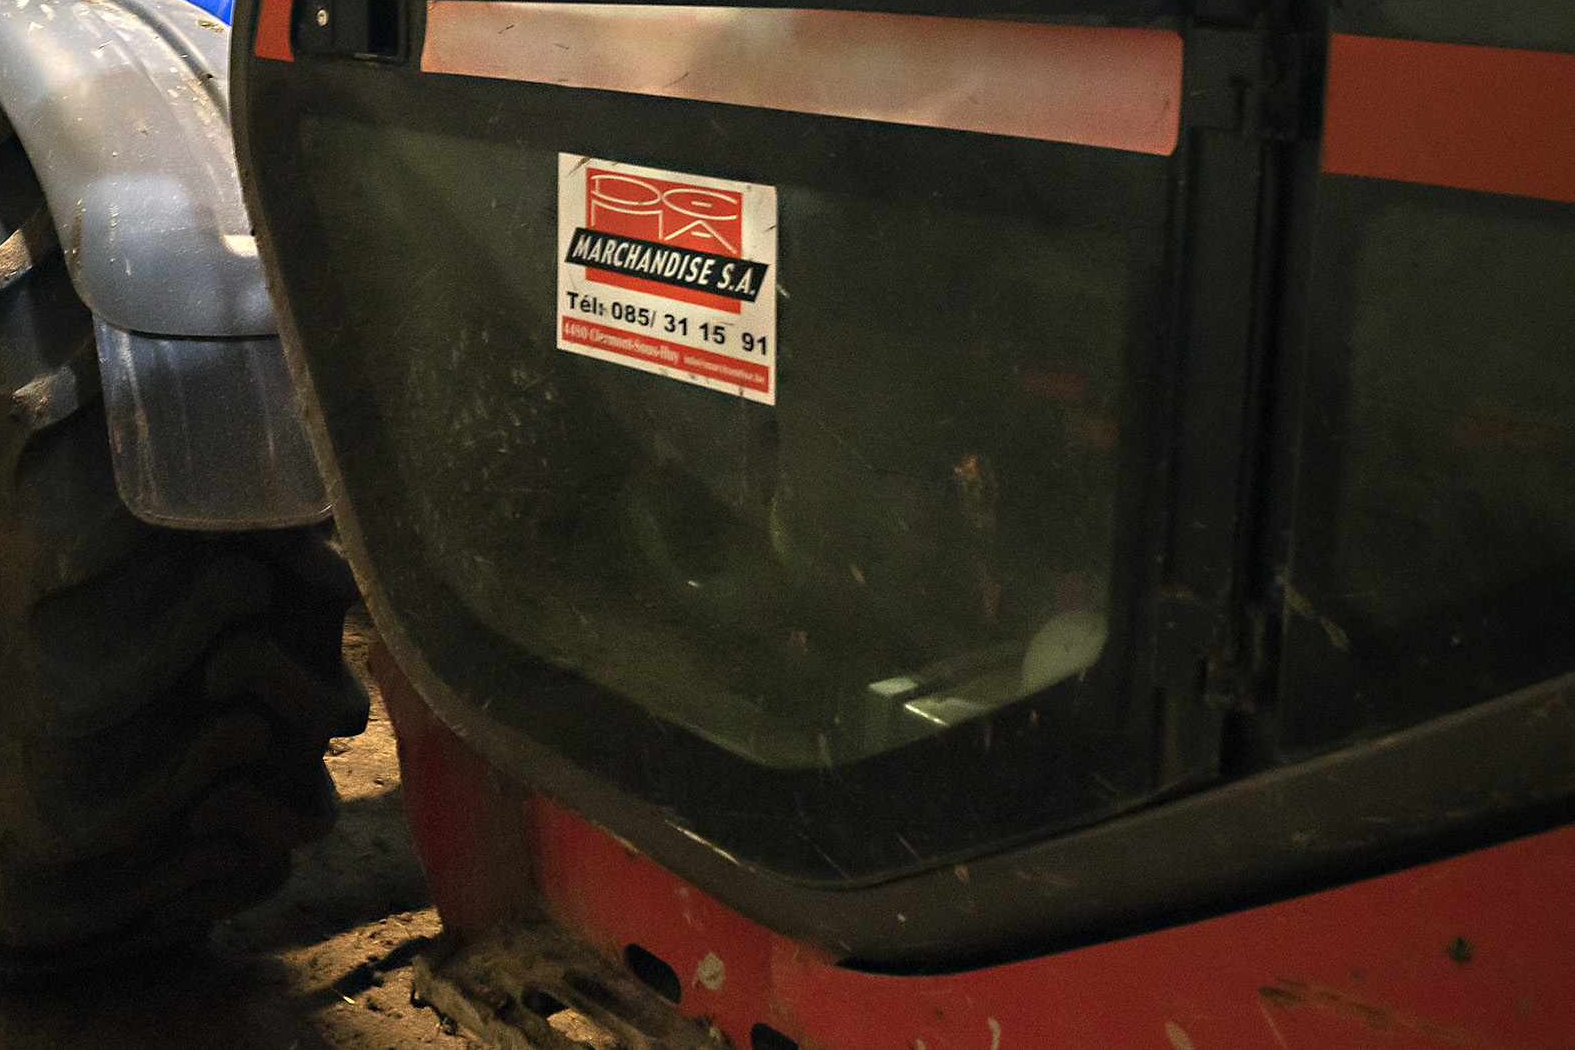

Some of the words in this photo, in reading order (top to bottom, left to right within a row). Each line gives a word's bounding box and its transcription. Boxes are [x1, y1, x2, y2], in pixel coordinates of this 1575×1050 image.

[572, 233, 716, 286] MARCHANDISE
[716, 263, 756, 296] S.A.
[566, 291, 603, 316] Tél:
[664, 314, 688, 336] 31
[700, 323, 726, 345] 15
[741, 332, 768, 356] 91
